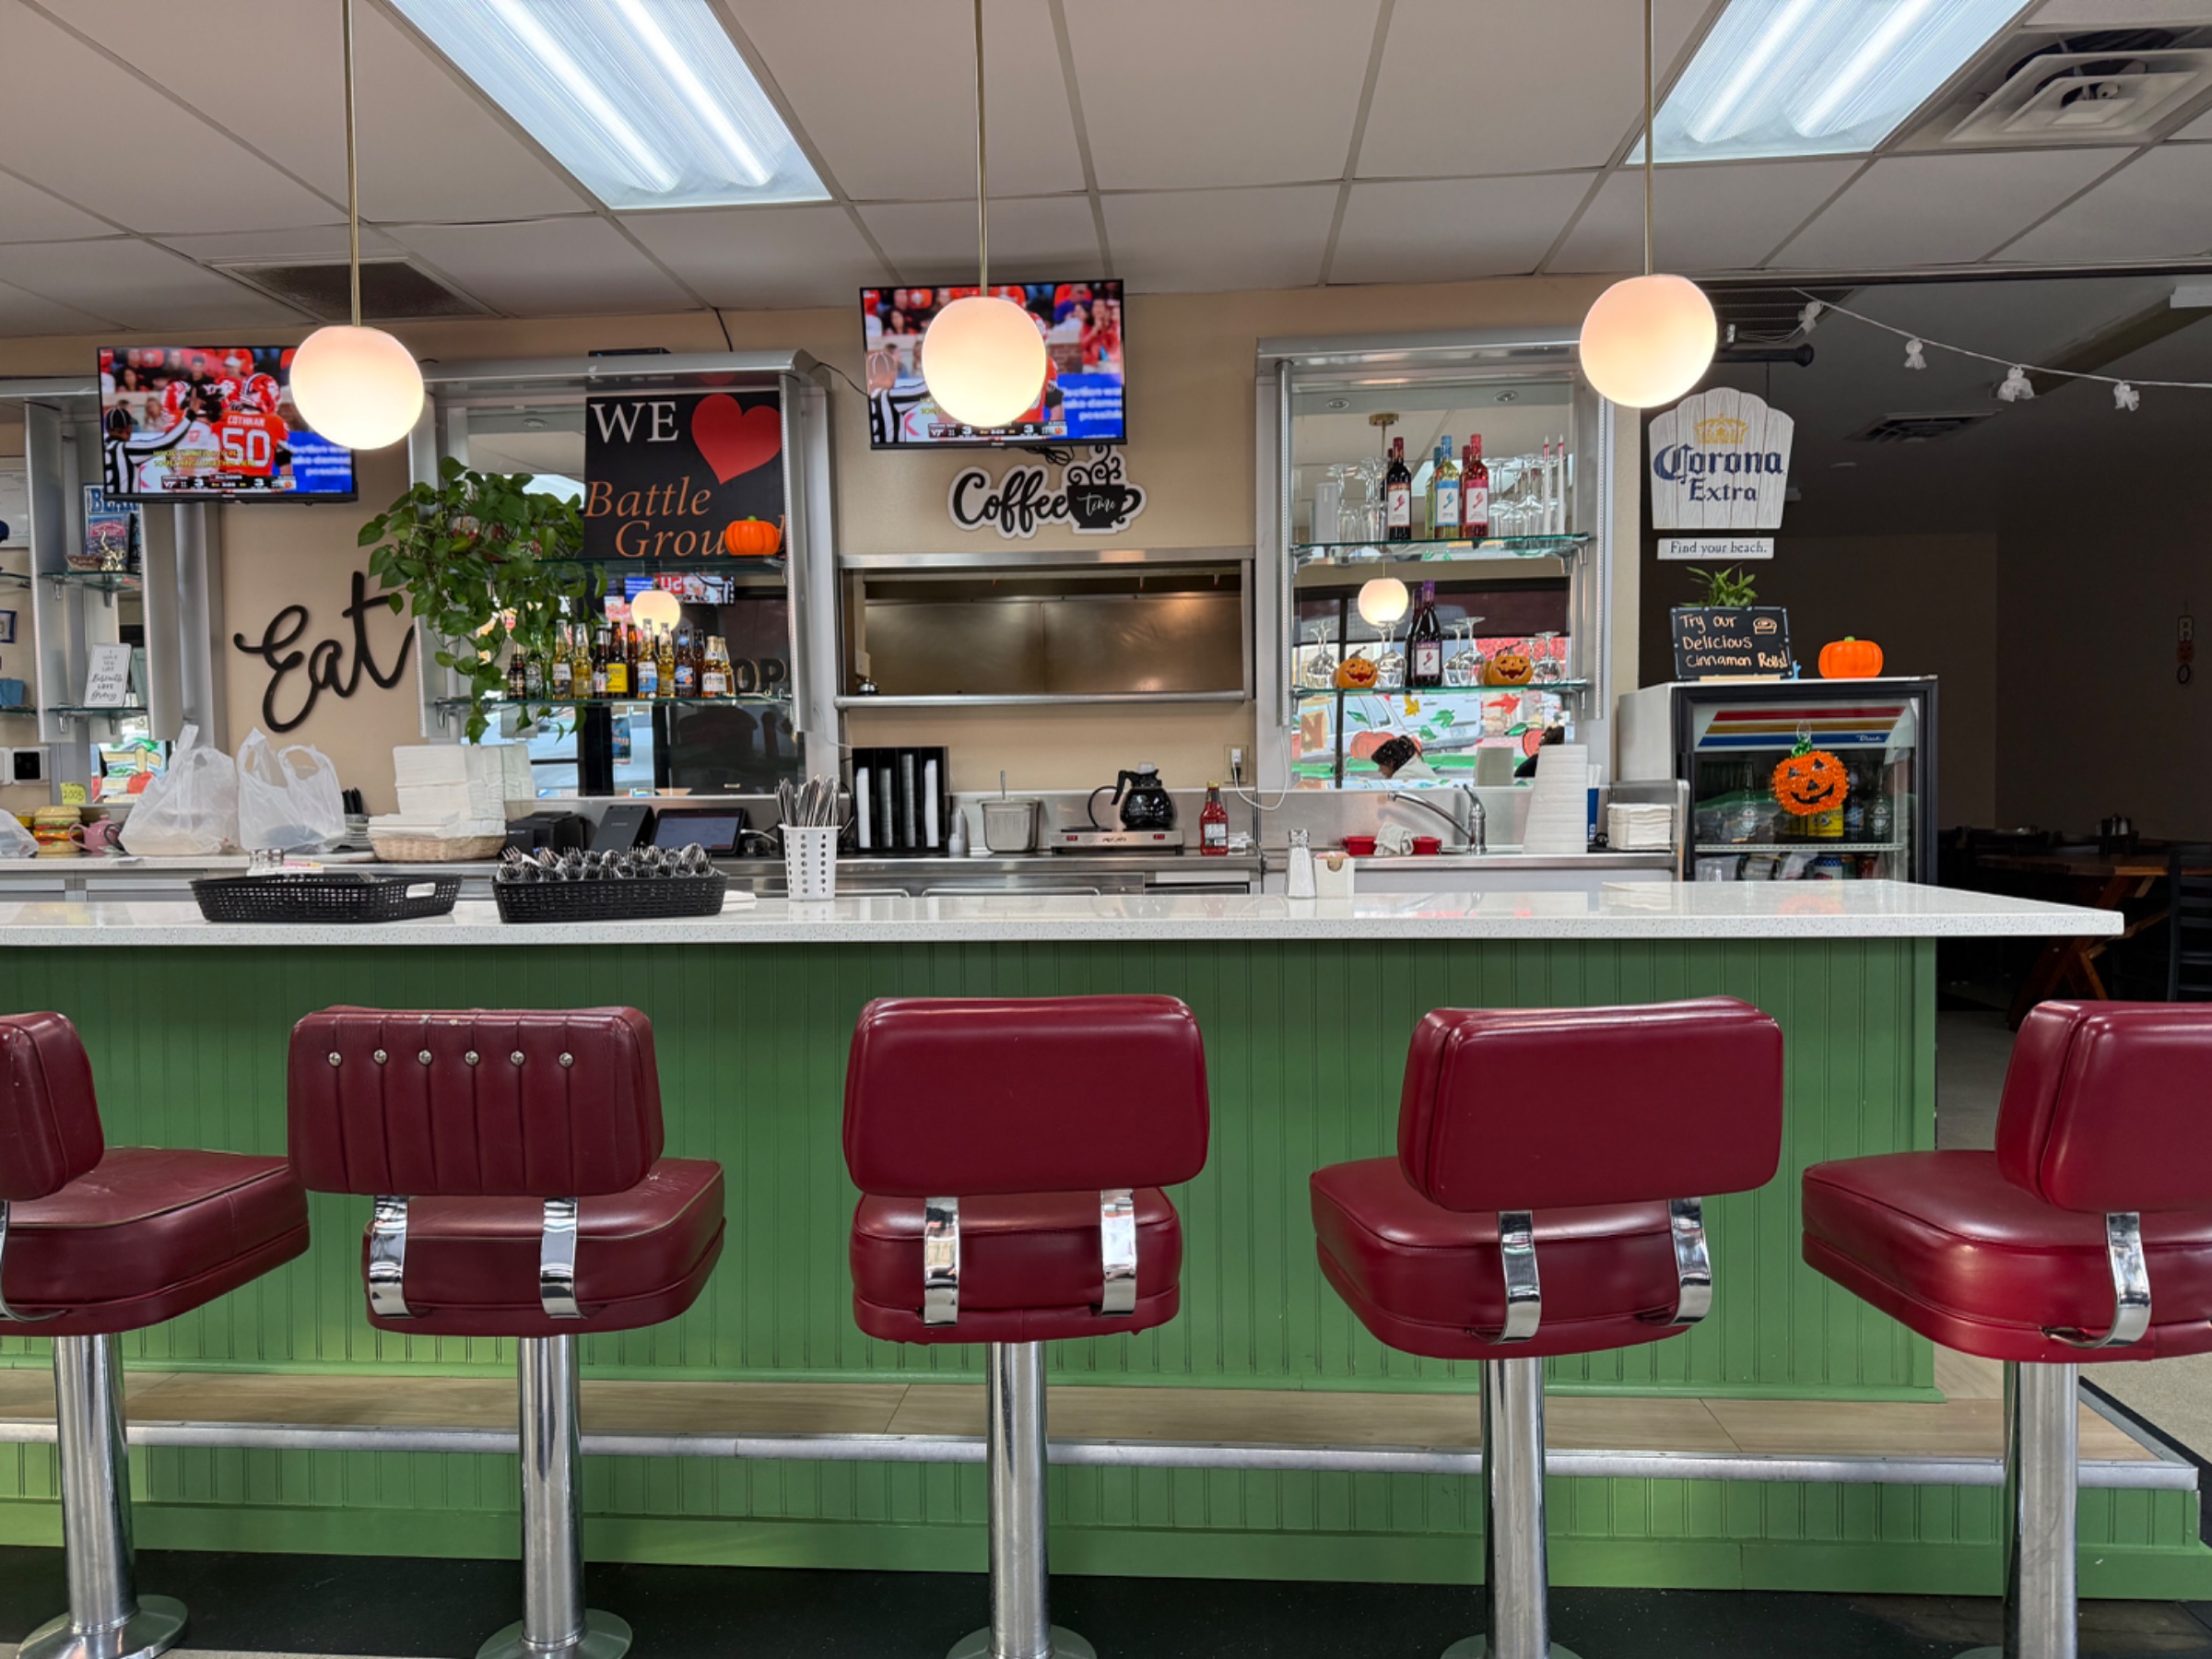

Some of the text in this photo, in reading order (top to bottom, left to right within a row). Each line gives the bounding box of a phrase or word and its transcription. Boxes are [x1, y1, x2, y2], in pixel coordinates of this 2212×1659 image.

[590, 401, 679, 443] WE
[222, 428, 271, 467] 50
[1653, 443, 1784, 485] Corona
[584, 476, 712, 518] Battle
[953, 470, 1070, 533] Coffee
[1688, 477, 1758, 501] Extra
[616, 514, 786, 559] Grou
[1671, 540, 1768, 558] Find your beach.
[1680, 614, 1737, 635] Try our
[1682, 635, 1753, 651] Delicious
[233, 571, 415, 734] Eat
